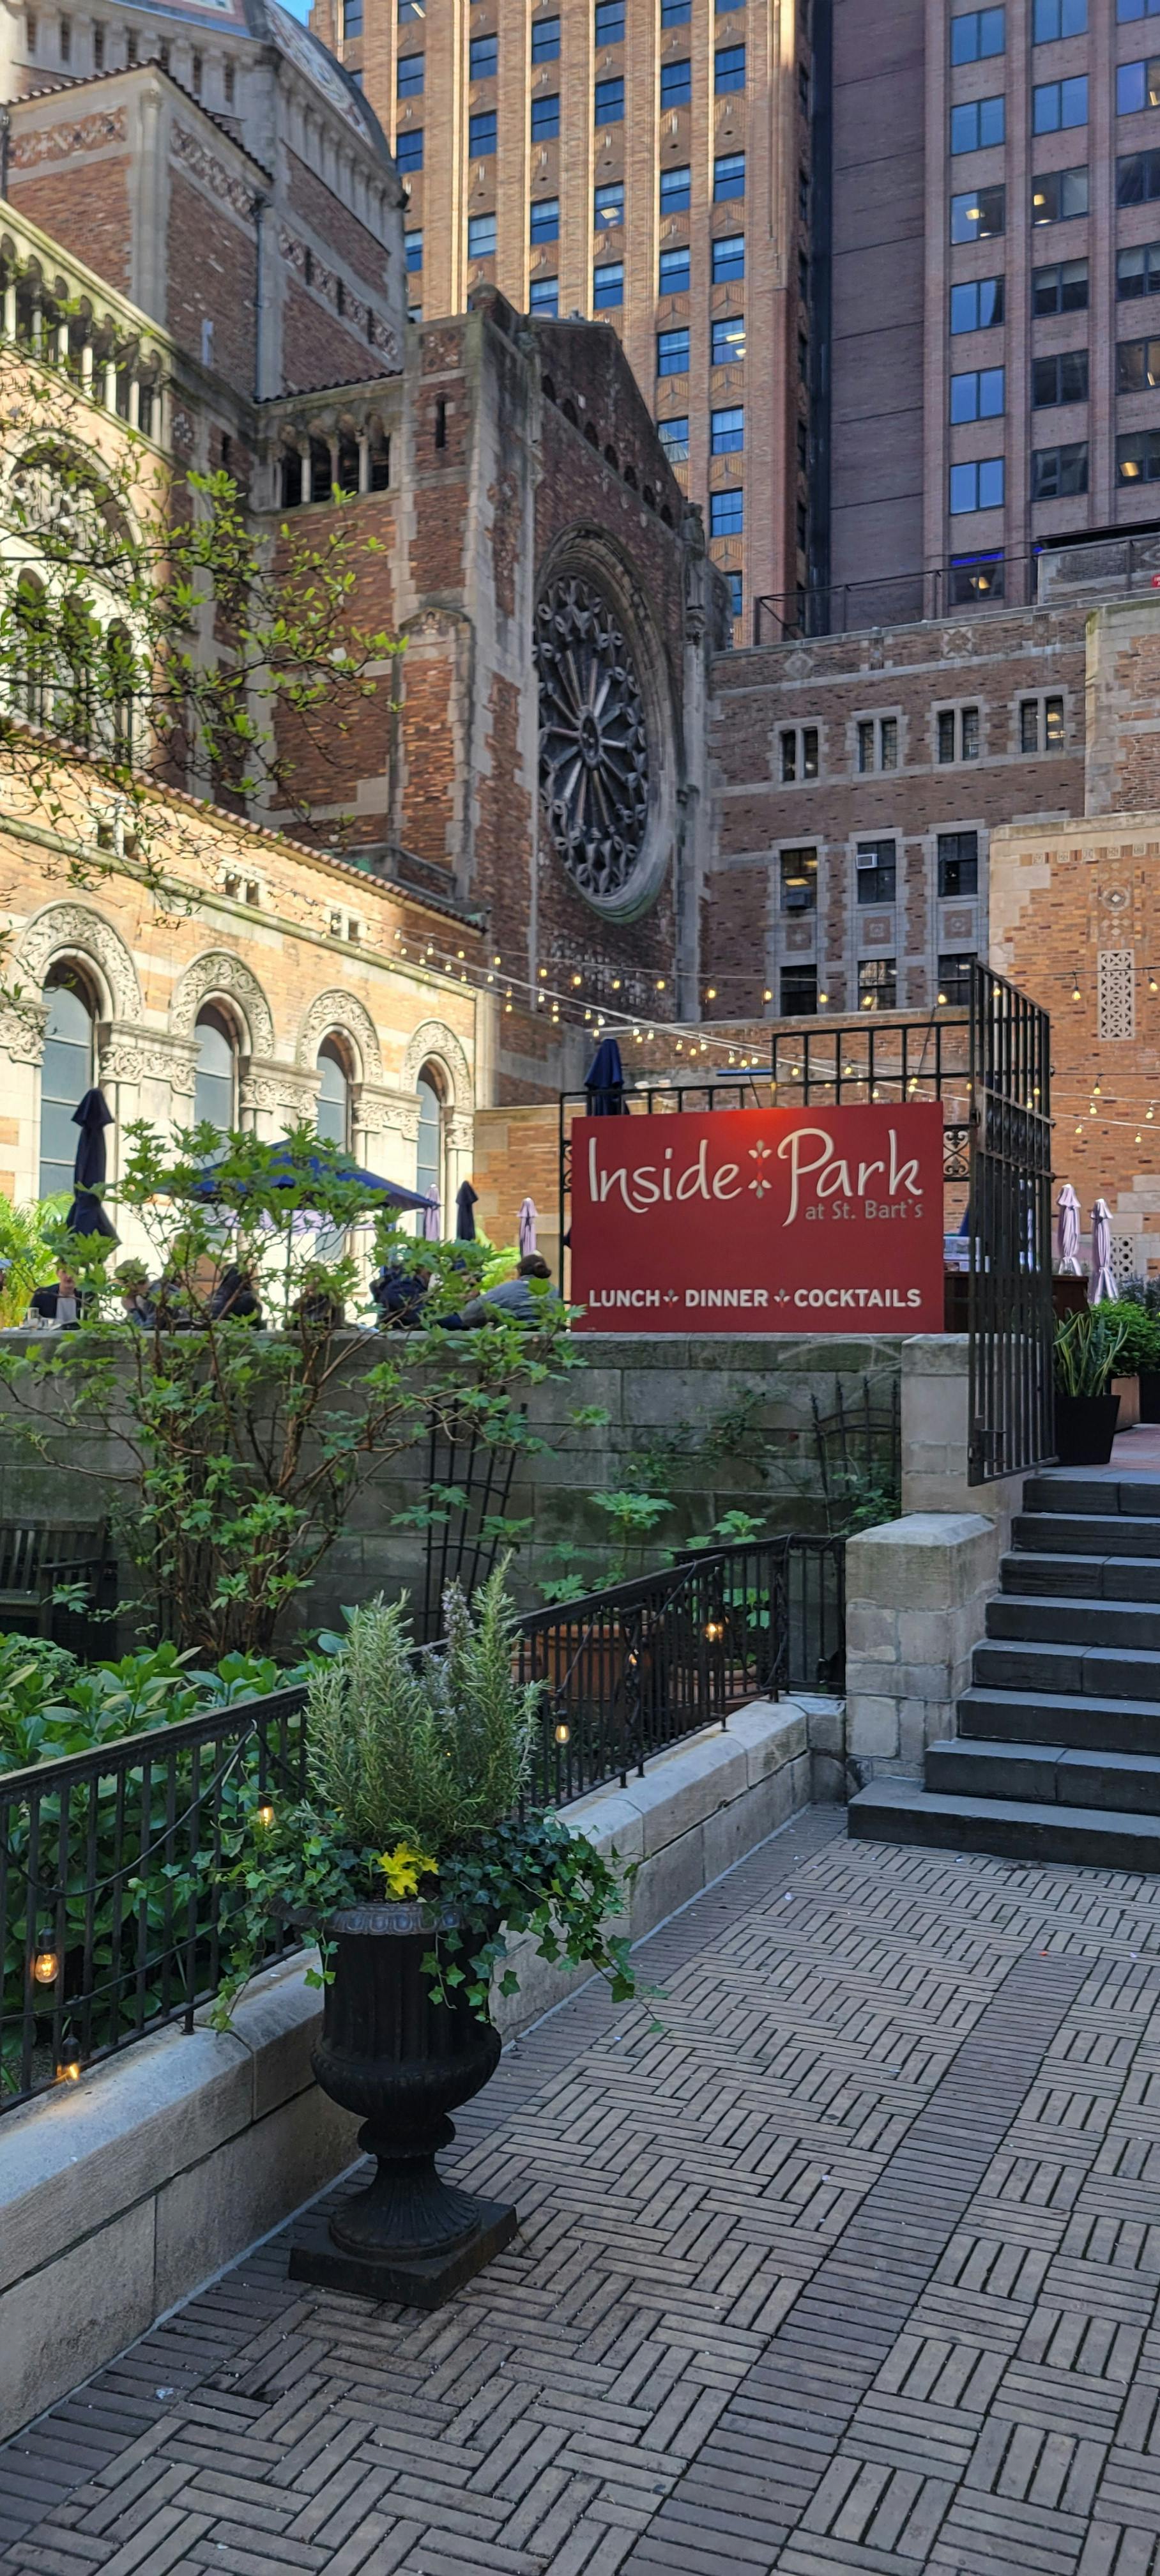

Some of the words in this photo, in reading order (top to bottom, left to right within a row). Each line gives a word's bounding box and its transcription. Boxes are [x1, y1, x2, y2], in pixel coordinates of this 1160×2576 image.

[588, 1137, 742, 1213] Inside
[777, 1127, 924, 1227] Park
[805, 1203, 825, 1220] at
[832, 1200, 856, 1220] St.
[865, 1199, 923, 1219] Bart's
[589, 1289, 660, 1307] LUNCH
[685, 1289, 768, 1307] DINNER
[794, 1288, 922, 1307] COCKTAILS
